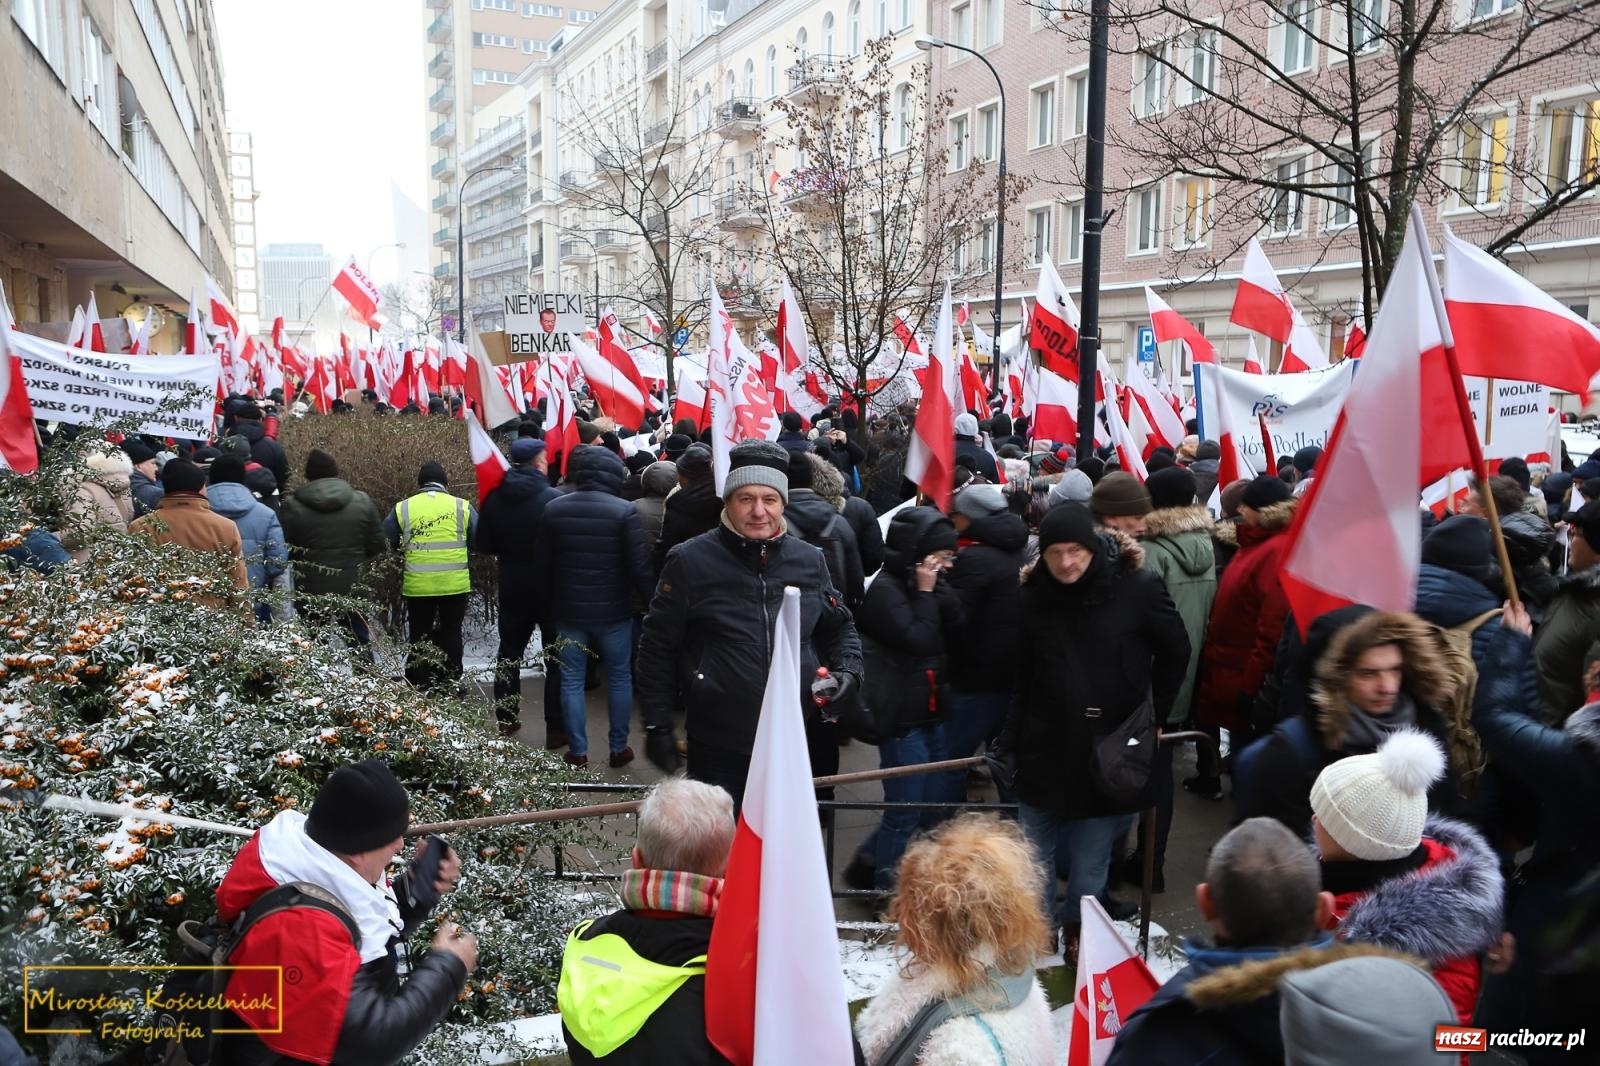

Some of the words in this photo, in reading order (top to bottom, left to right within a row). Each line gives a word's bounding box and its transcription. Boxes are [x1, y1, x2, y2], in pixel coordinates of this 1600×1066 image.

[505, 293, 583, 315] NIEMIECKI
[511, 333, 580, 353] BENKAR
[1499, 383, 1542, 397] WOLNE
[1251, 400, 1289, 418] PiS
[1500, 403, 1539, 417] MEDIA
